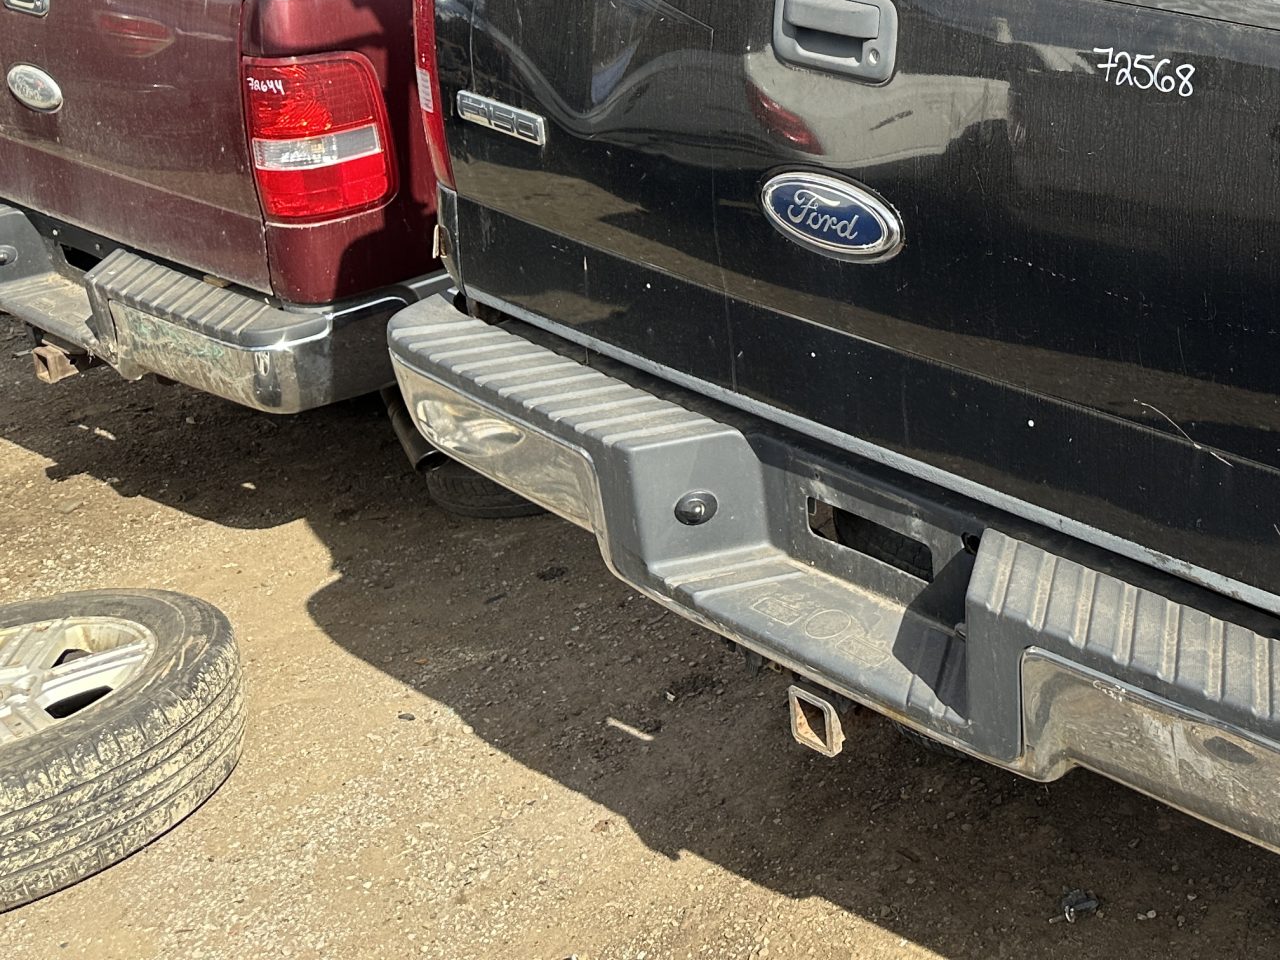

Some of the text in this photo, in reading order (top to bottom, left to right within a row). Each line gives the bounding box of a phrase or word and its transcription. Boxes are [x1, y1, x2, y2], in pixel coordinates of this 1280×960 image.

[246, 76, 286, 96] 72644
[1093, 47, 1196, 97] 72568
[787, 189, 859, 240] Ford
